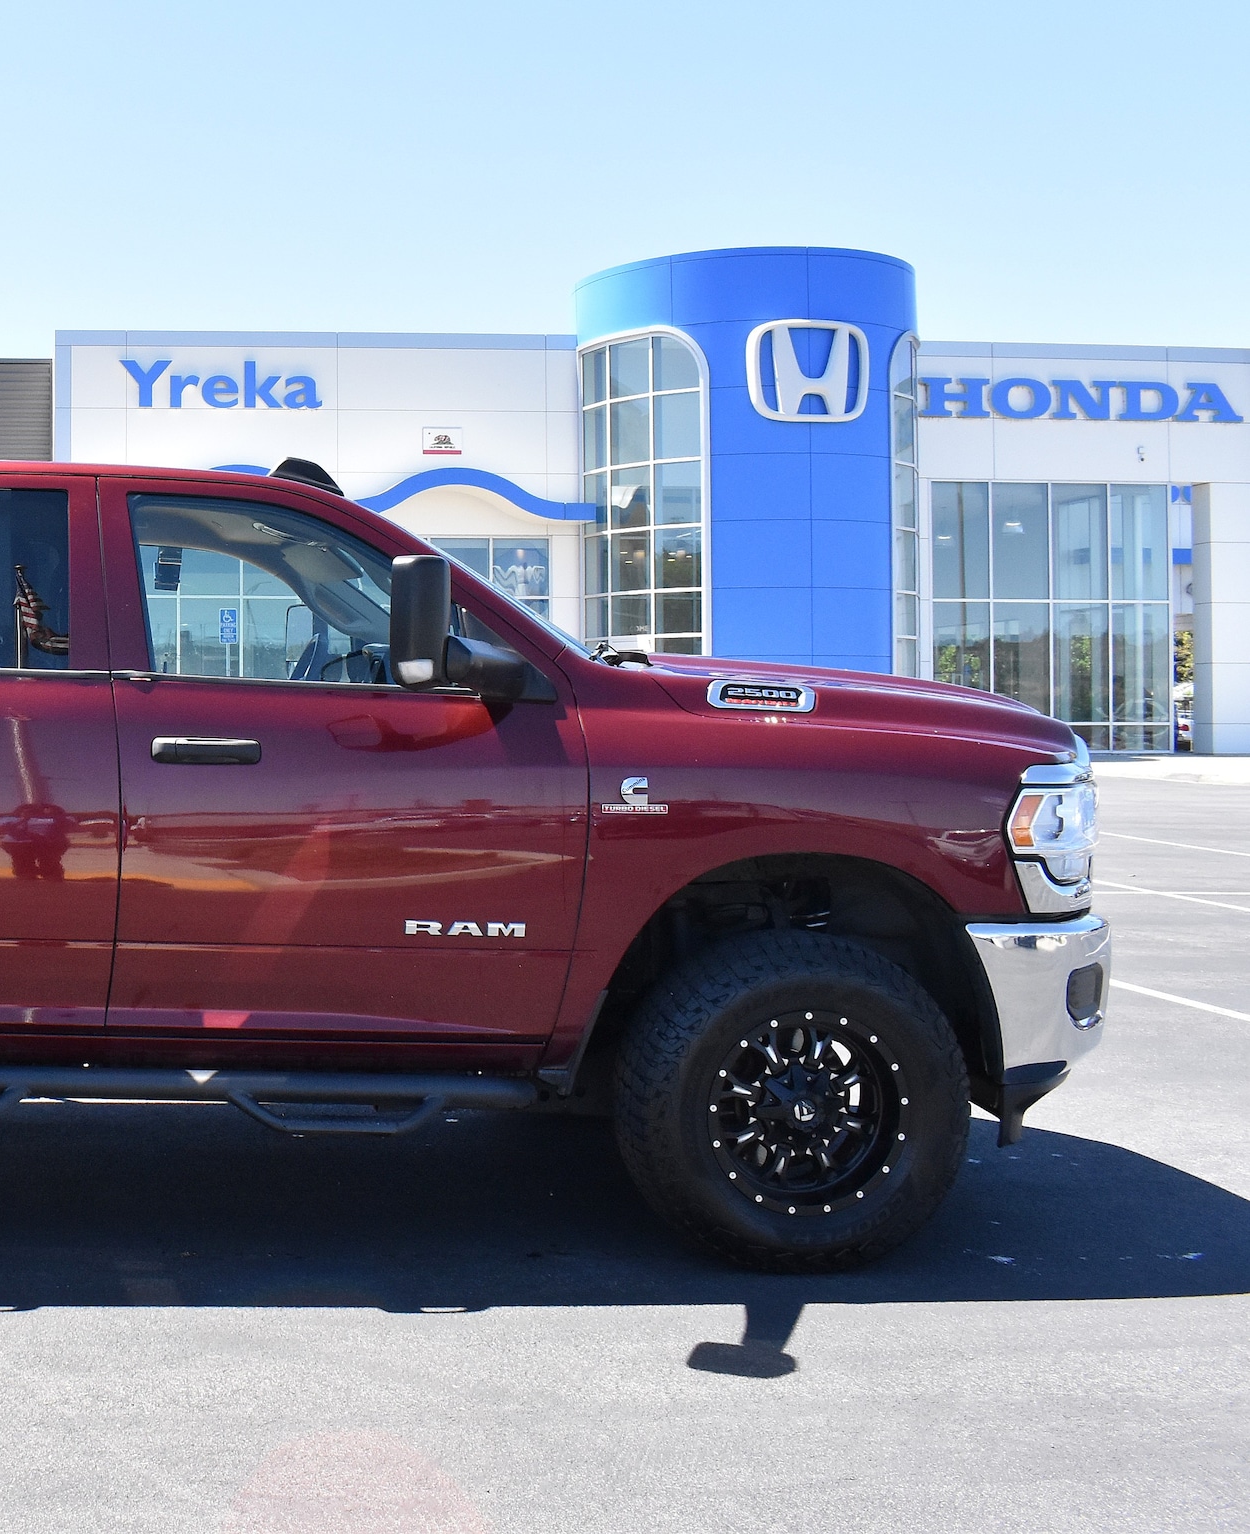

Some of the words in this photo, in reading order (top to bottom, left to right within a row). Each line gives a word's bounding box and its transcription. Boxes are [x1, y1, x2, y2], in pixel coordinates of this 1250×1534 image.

[118, 359, 323, 409] Yreka
[918, 377, 1244, 423] HONDA
[727, 687, 797, 699] 2500
[621, 777, 646, 793] Cummins
[404, 920, 526, 938] RAM
